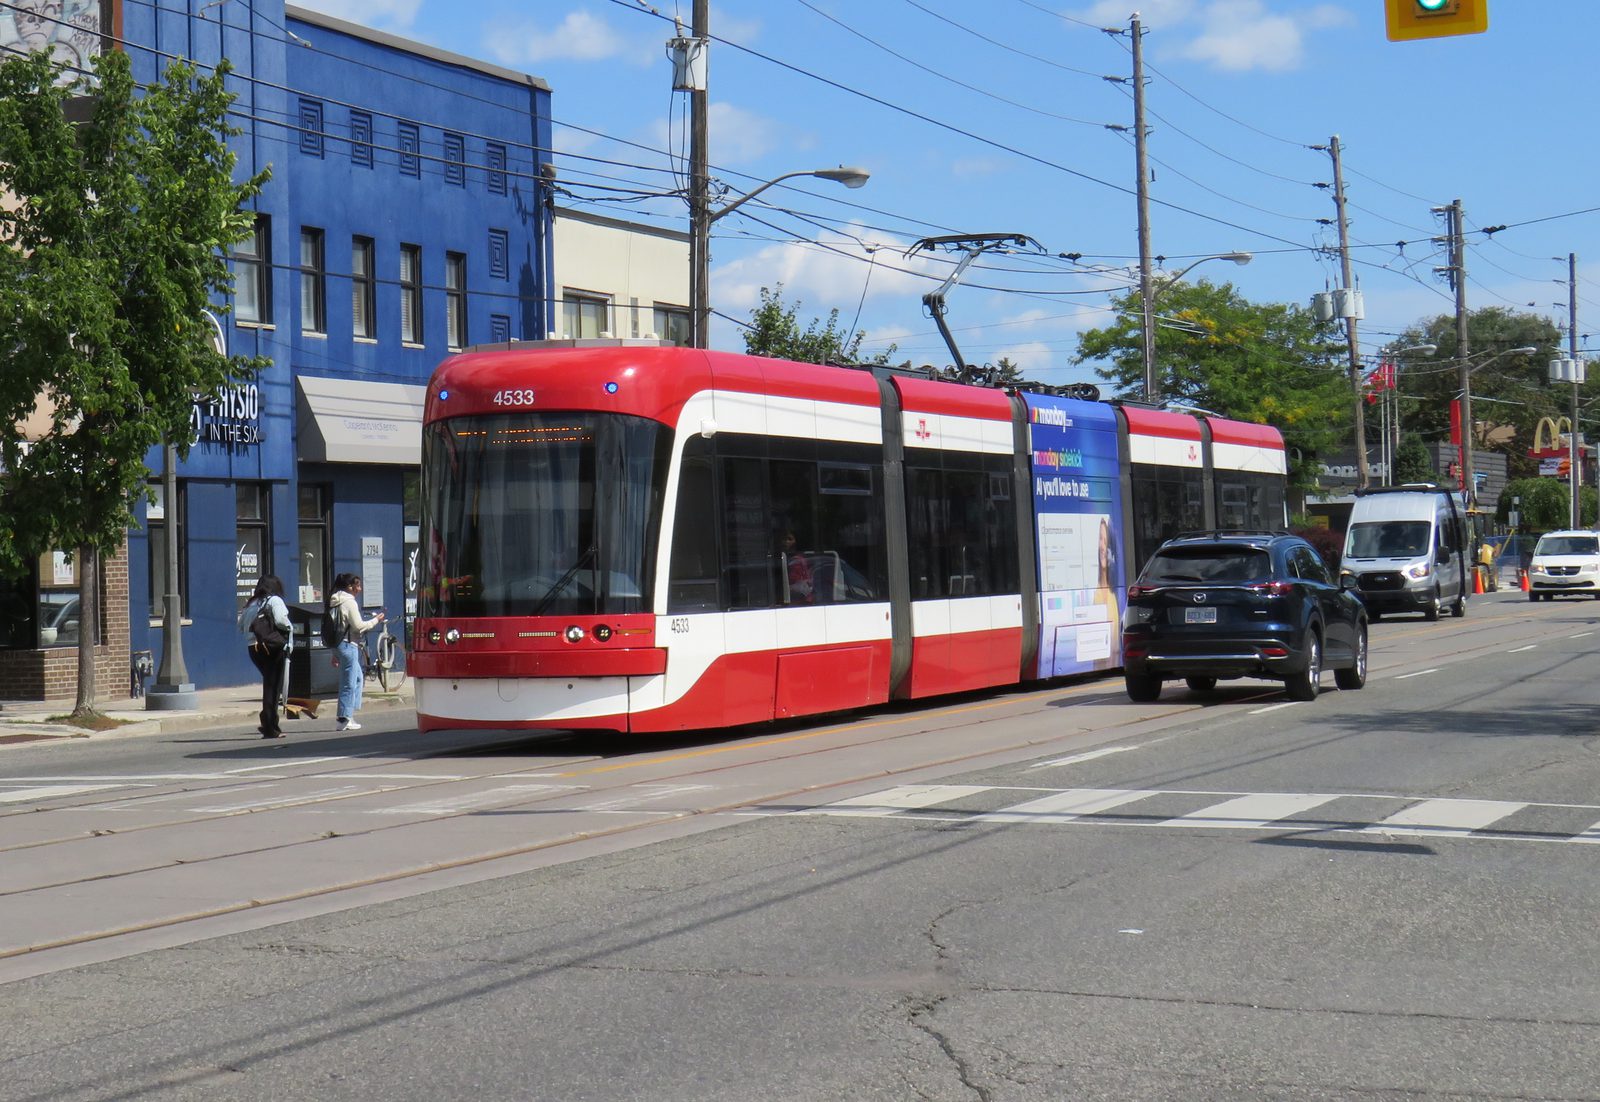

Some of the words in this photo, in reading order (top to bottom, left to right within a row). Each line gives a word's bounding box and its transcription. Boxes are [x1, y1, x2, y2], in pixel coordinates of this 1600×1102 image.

[493, 389, 534, 406] 4533
[210, 423, 220, 441] IN
[222, 424, 242, 442] THE
[243, 425, 259, 443] SIX
[1034, 447, 1058, 471] monday
[1059, 477, 1072, 497] love
[1072, 479, 1079, 497] to
[1080, 483, 1089, 498] use
[366, 544, 379, 556] 2794
[671, 617, 690, 634] 4533
